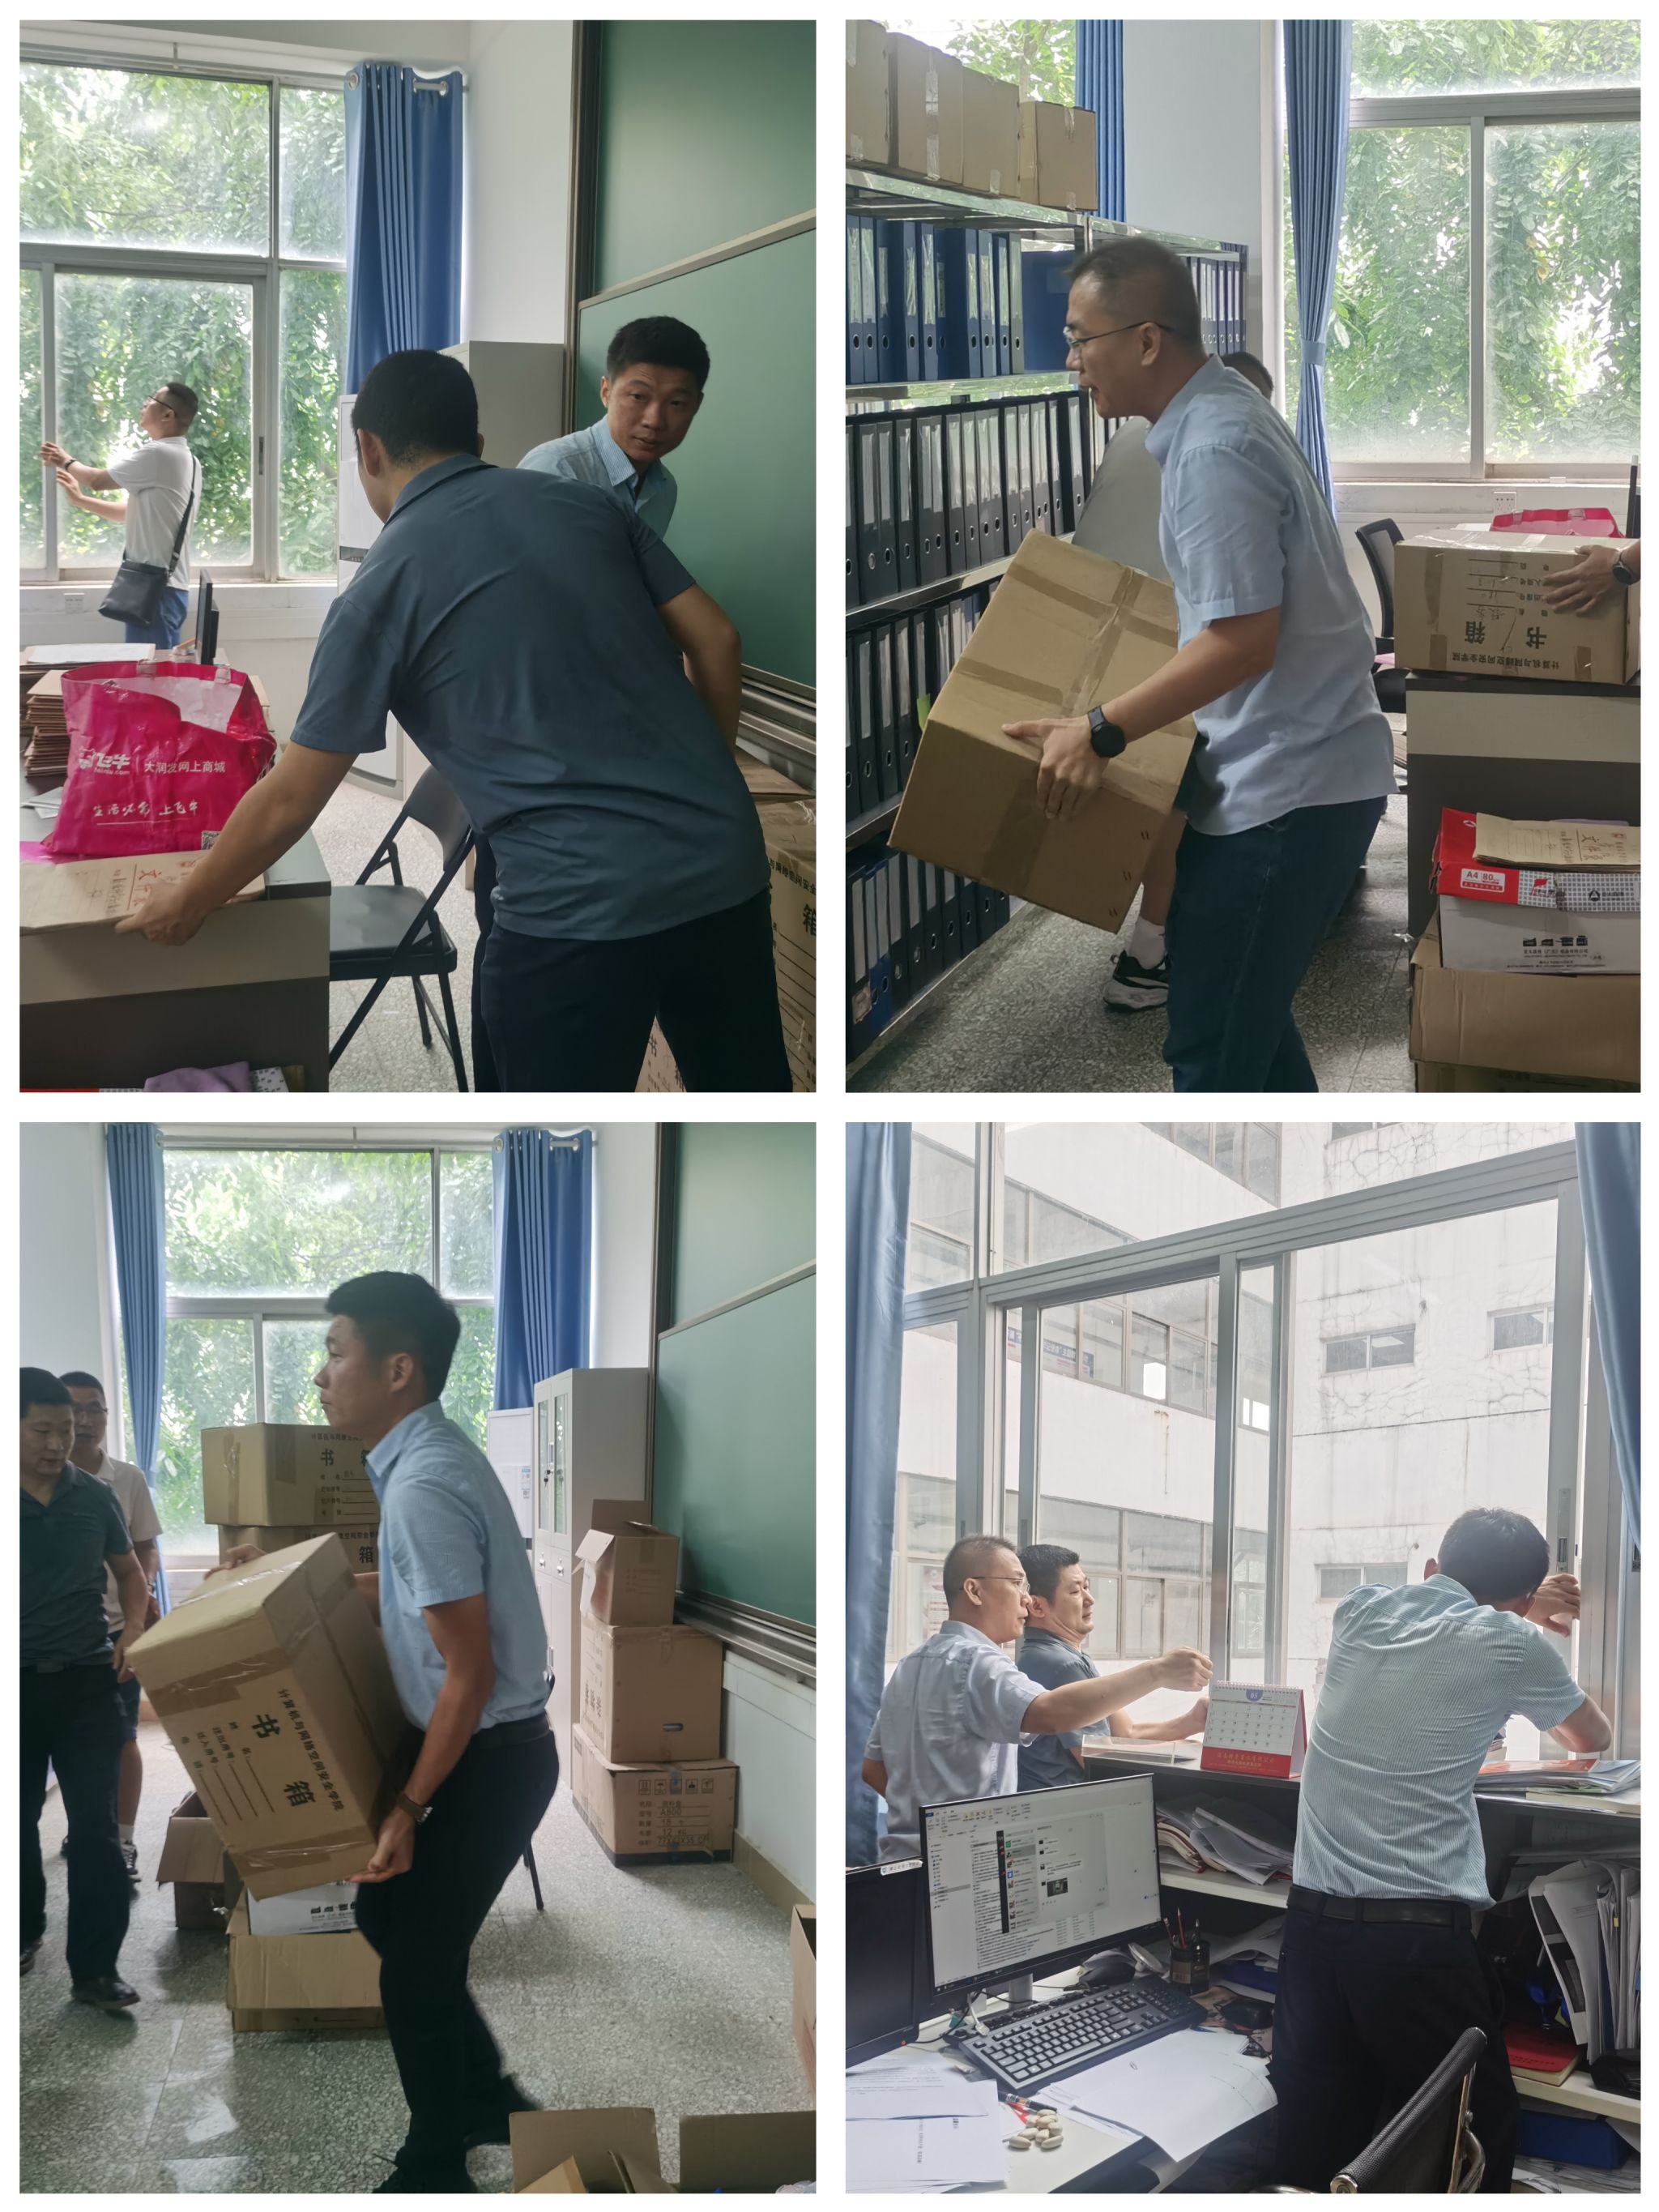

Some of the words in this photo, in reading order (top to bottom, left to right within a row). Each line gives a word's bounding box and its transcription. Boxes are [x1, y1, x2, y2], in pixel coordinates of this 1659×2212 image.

[1464, 621, 1486, 644] 箱
[1525, 626, 1547, 649] 书
[1466, 871, 1478, 880] A4
[1482, 873, 1493, 881] 80
[359, 1546, 373, 1564] 箱
[251, 1714, 281, 1739] 书
[284, 1780, 316, 1807] 箱
[278, 1689, 344, 1811] 计算机与网络空间安全学院
